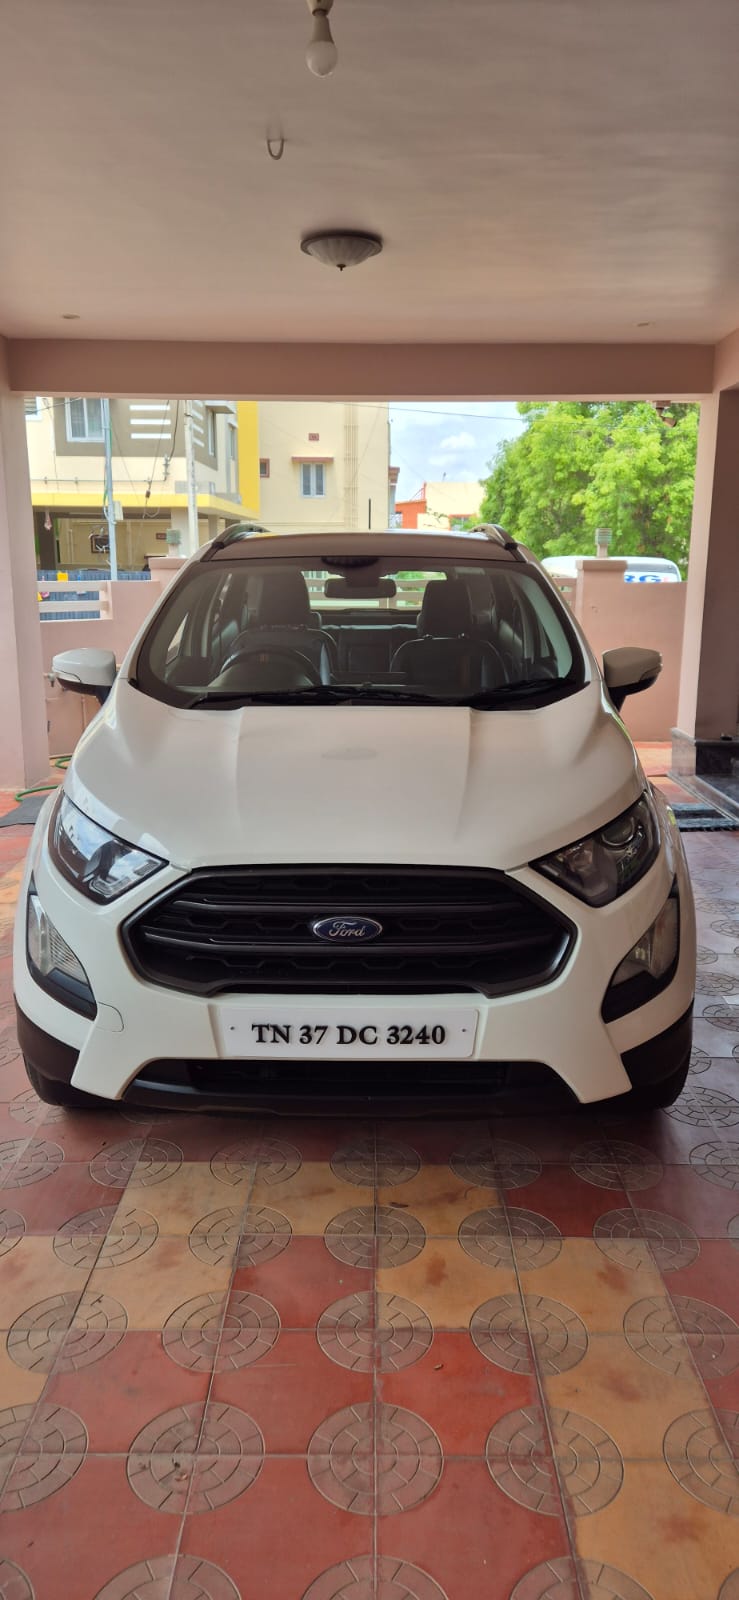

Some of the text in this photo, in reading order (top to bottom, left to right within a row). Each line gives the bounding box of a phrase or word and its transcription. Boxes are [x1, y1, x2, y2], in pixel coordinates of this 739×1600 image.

[329, 921, 366, 936] Ford
[252, 1024, 446, 1045] TN 37 DC 3240
